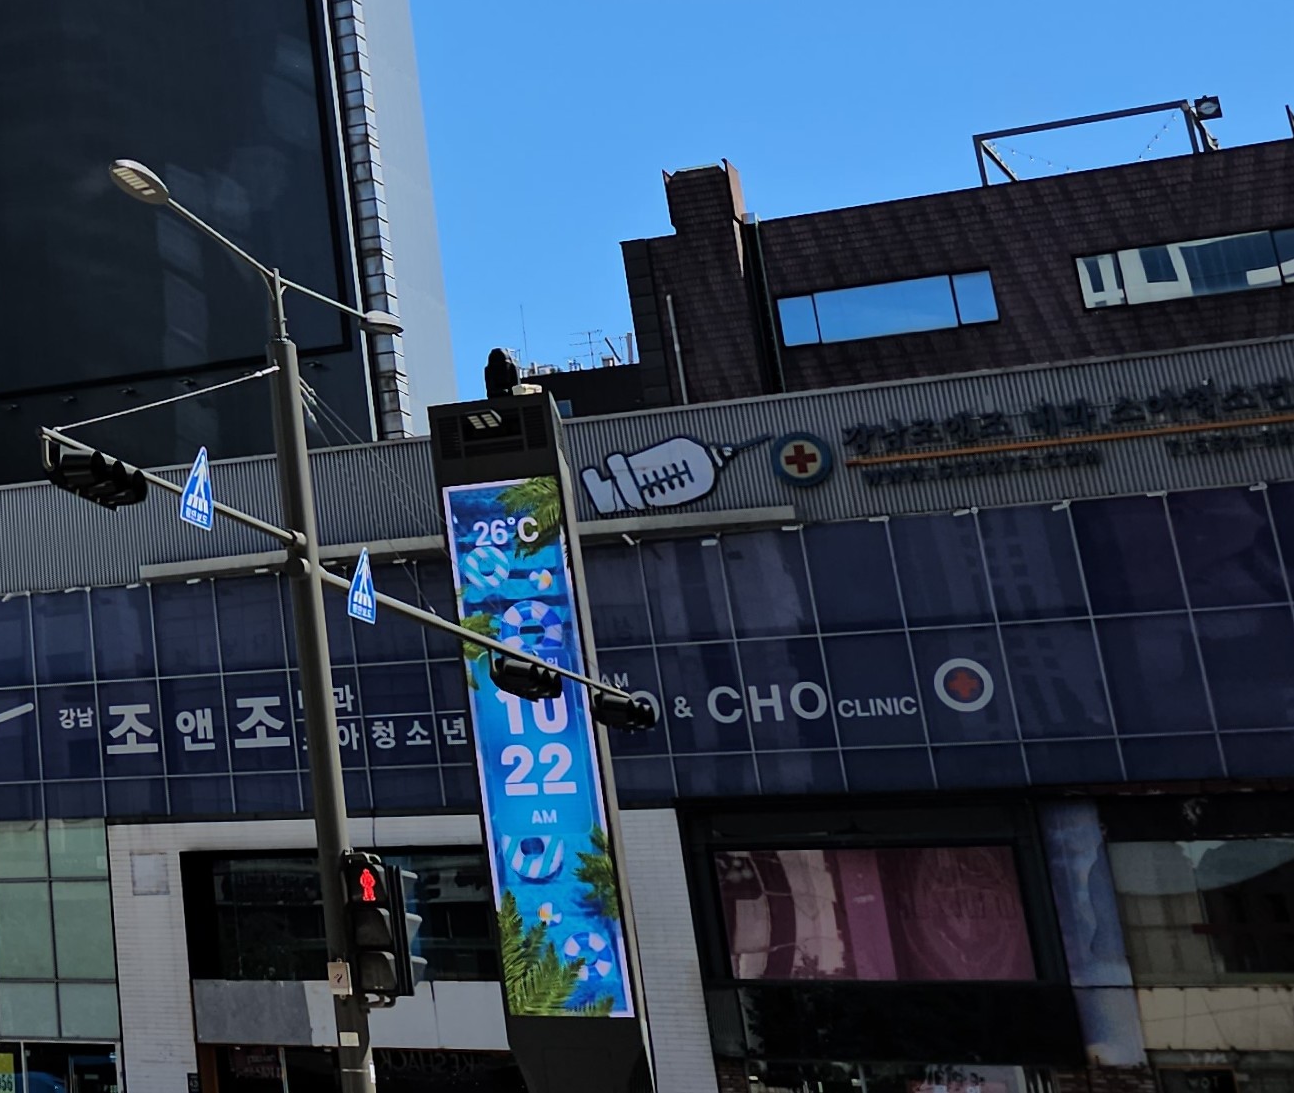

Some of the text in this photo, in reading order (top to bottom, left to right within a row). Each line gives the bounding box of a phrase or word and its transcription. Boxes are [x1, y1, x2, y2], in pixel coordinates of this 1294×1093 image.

[473, 515, 540, 547] 26°C
[58, 707, 95, 730] 강남
[673, 695, 693, 718] &
[706, 680, 829, 725] CHO
[837, 693, 918, 720] CLINIC
[502, 743, 579, 798] 22
[531, 808, 559, 825] AM
